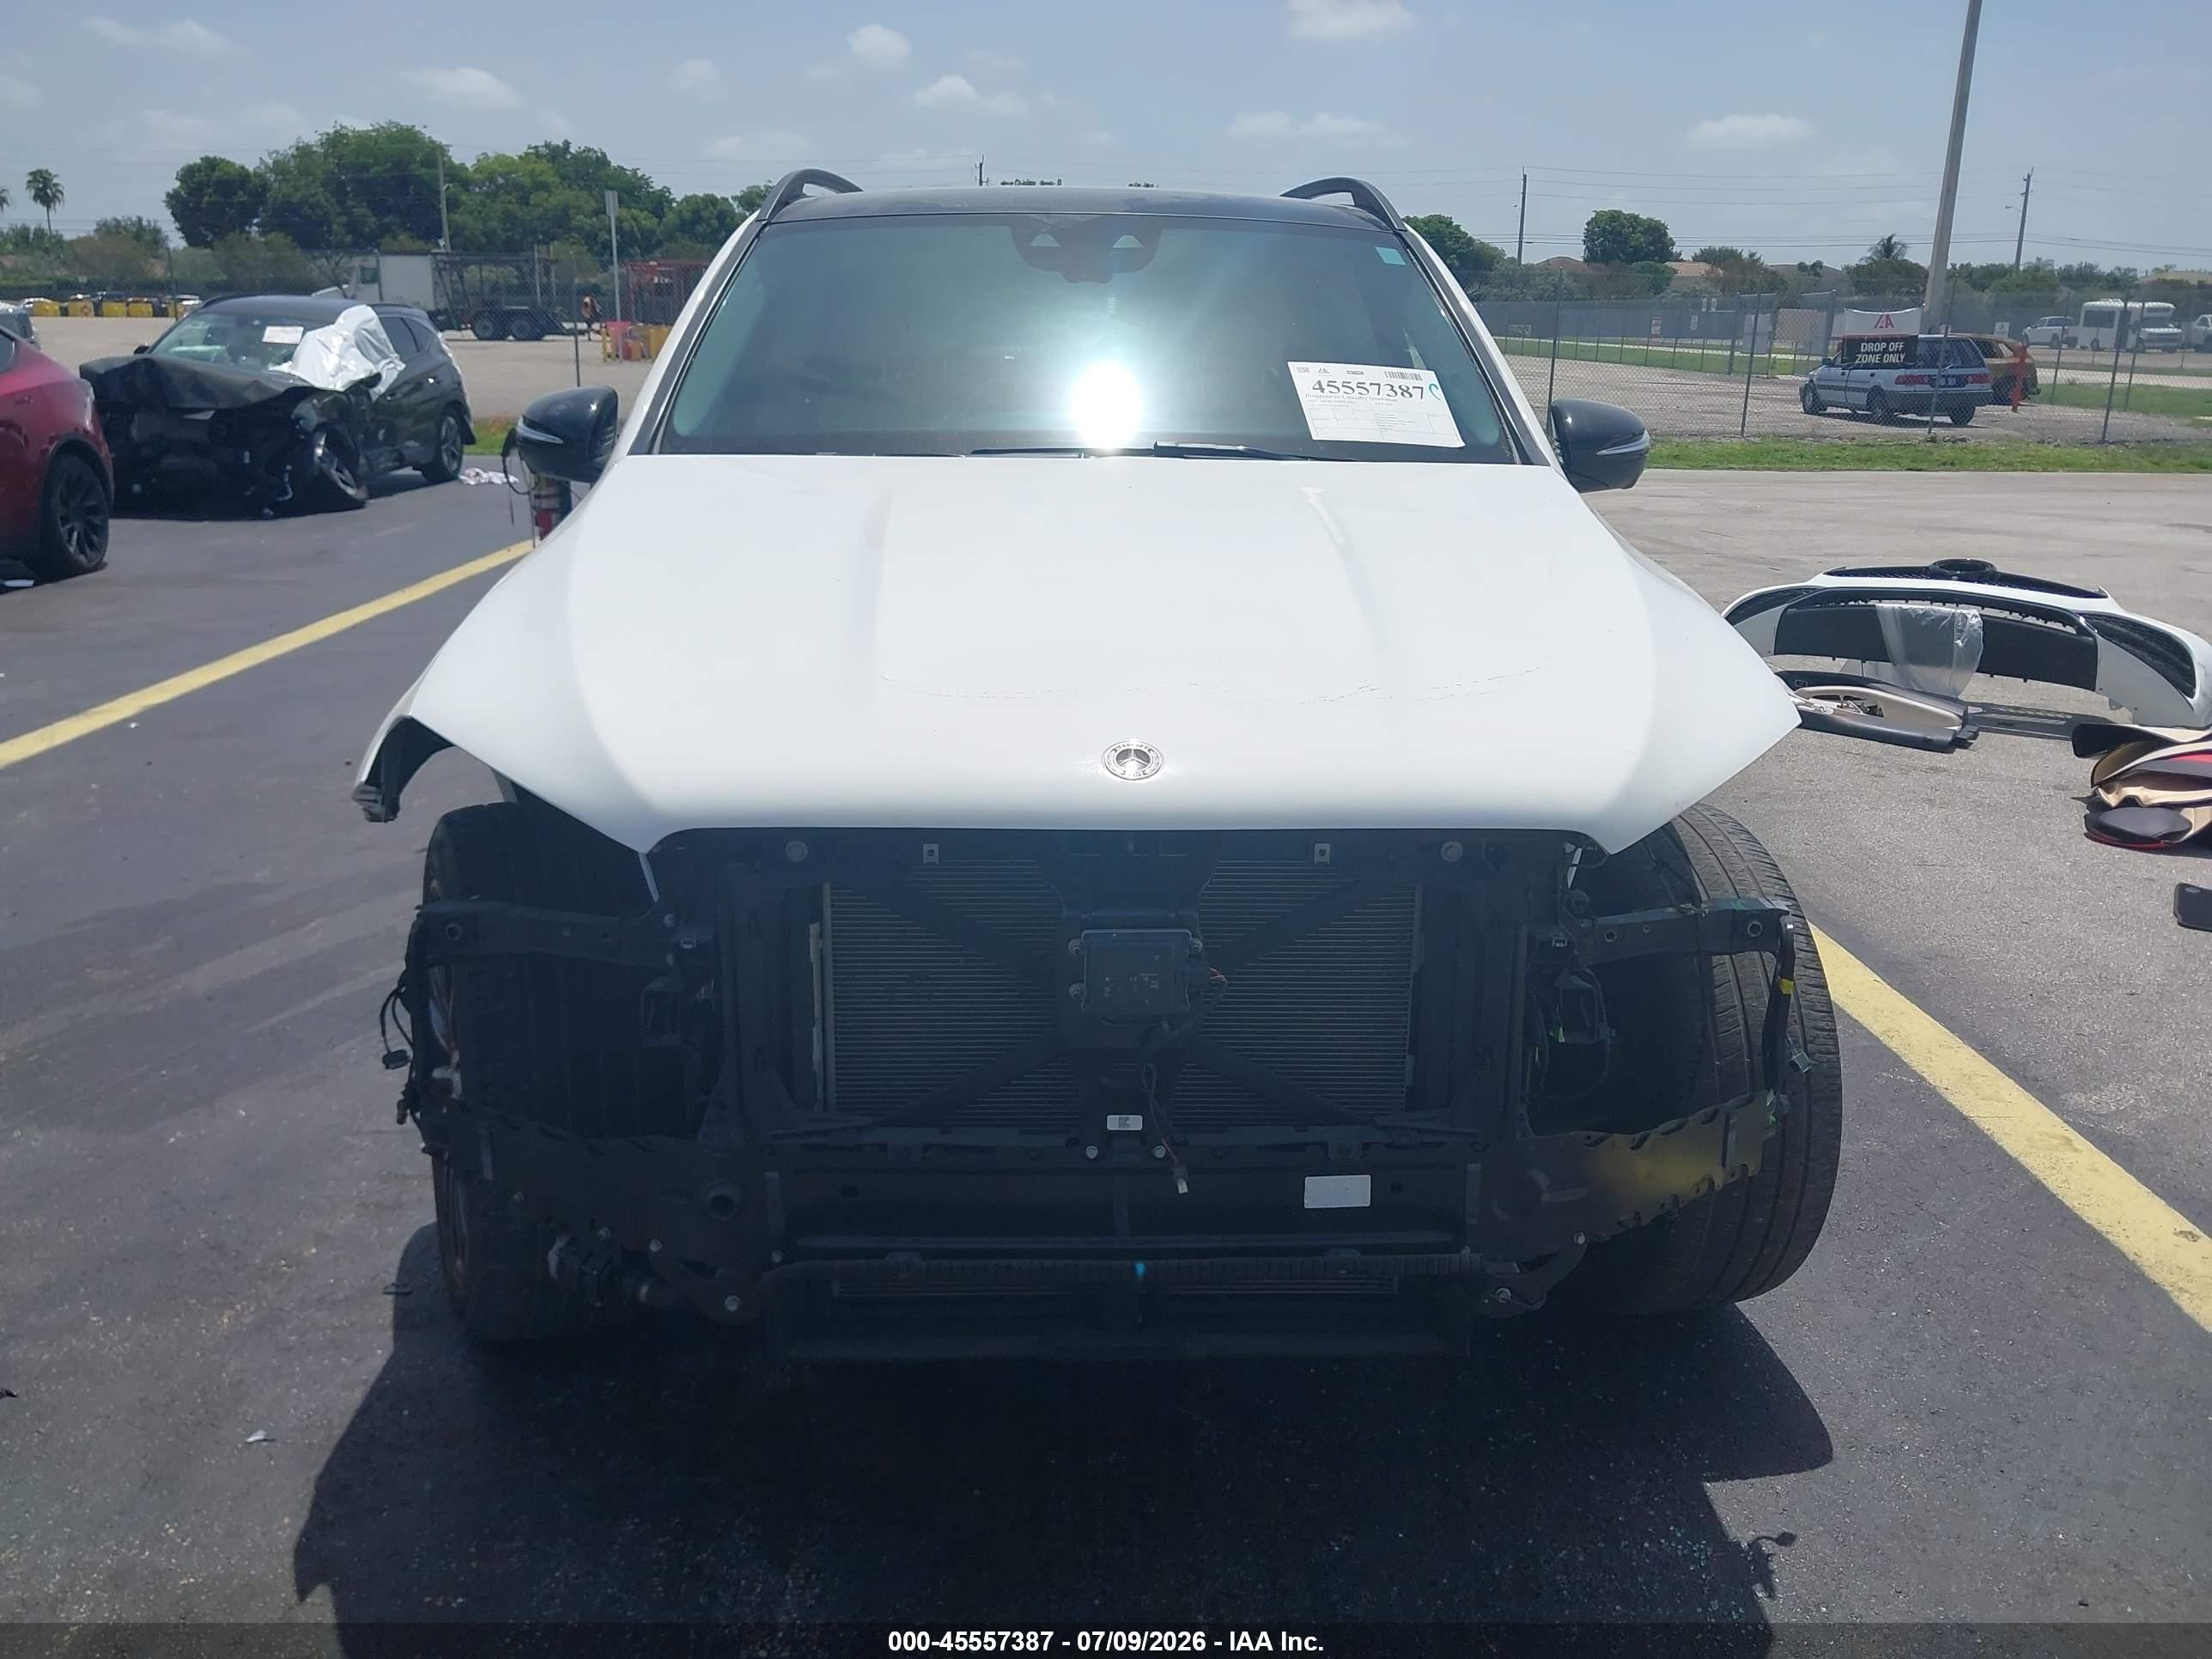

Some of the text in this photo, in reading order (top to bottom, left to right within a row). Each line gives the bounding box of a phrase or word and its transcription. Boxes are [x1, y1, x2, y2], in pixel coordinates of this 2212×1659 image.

[1861, 342, 1905, 352] DROP OFF
[1855, 353, 1905, 364] ZONE ONLY
[1312, 380, 1424, 400] 45557387
